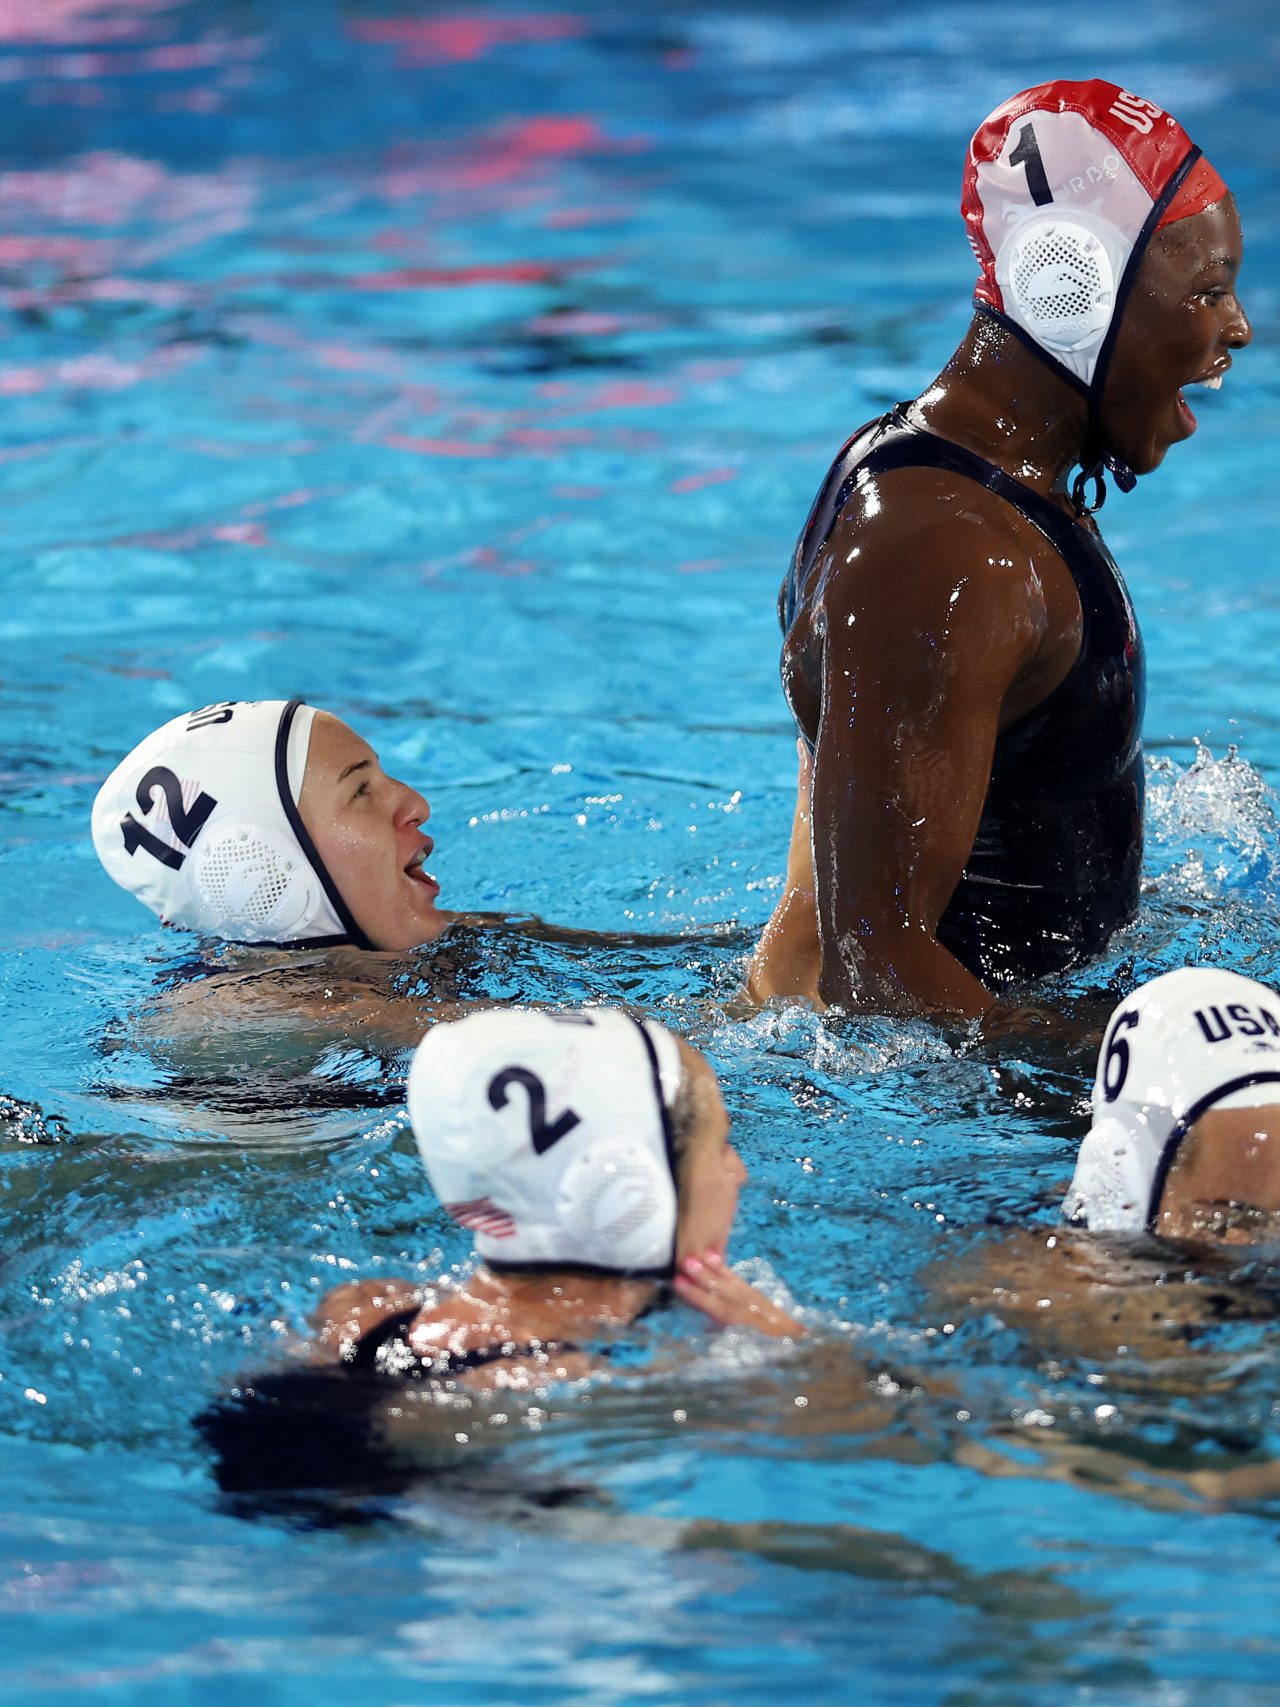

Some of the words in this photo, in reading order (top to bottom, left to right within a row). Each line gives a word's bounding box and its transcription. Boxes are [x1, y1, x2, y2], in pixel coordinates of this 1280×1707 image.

[1108, 89, 1165, 134] US
[1009, 122, 1054, 207] 1
[120, 765, 218, 871] 12
[1103, 1009, 1140, 1103] 6
[488, 1065, 582, 1155] 2
